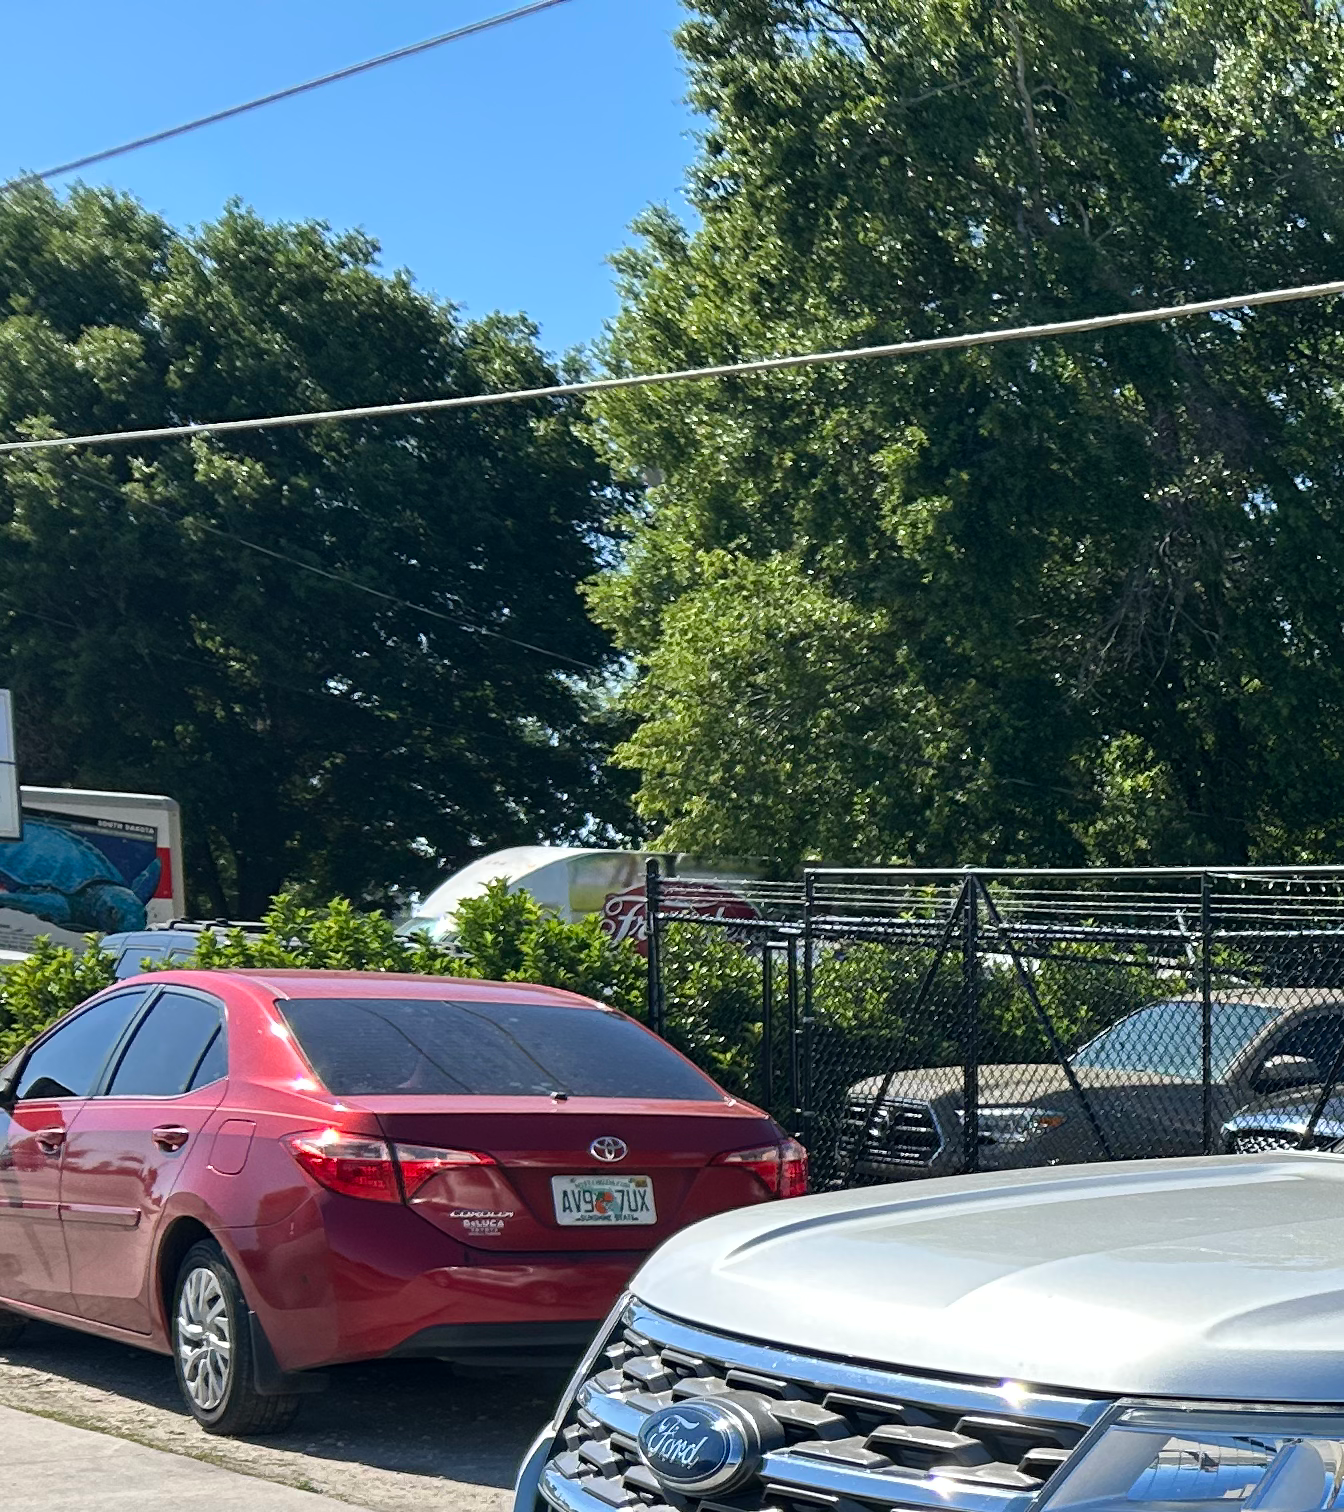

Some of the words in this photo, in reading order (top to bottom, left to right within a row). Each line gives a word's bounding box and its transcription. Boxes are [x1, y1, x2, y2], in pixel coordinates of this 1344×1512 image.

[97, 820, 123, 830] SOUTH
[125, 824, 155, 834] DAKOTA
[562, 1190, 594, 1213] AV9
[615, 1189, 650, 1213] 7UX
[648, 1414, 708, 1467] Ford
